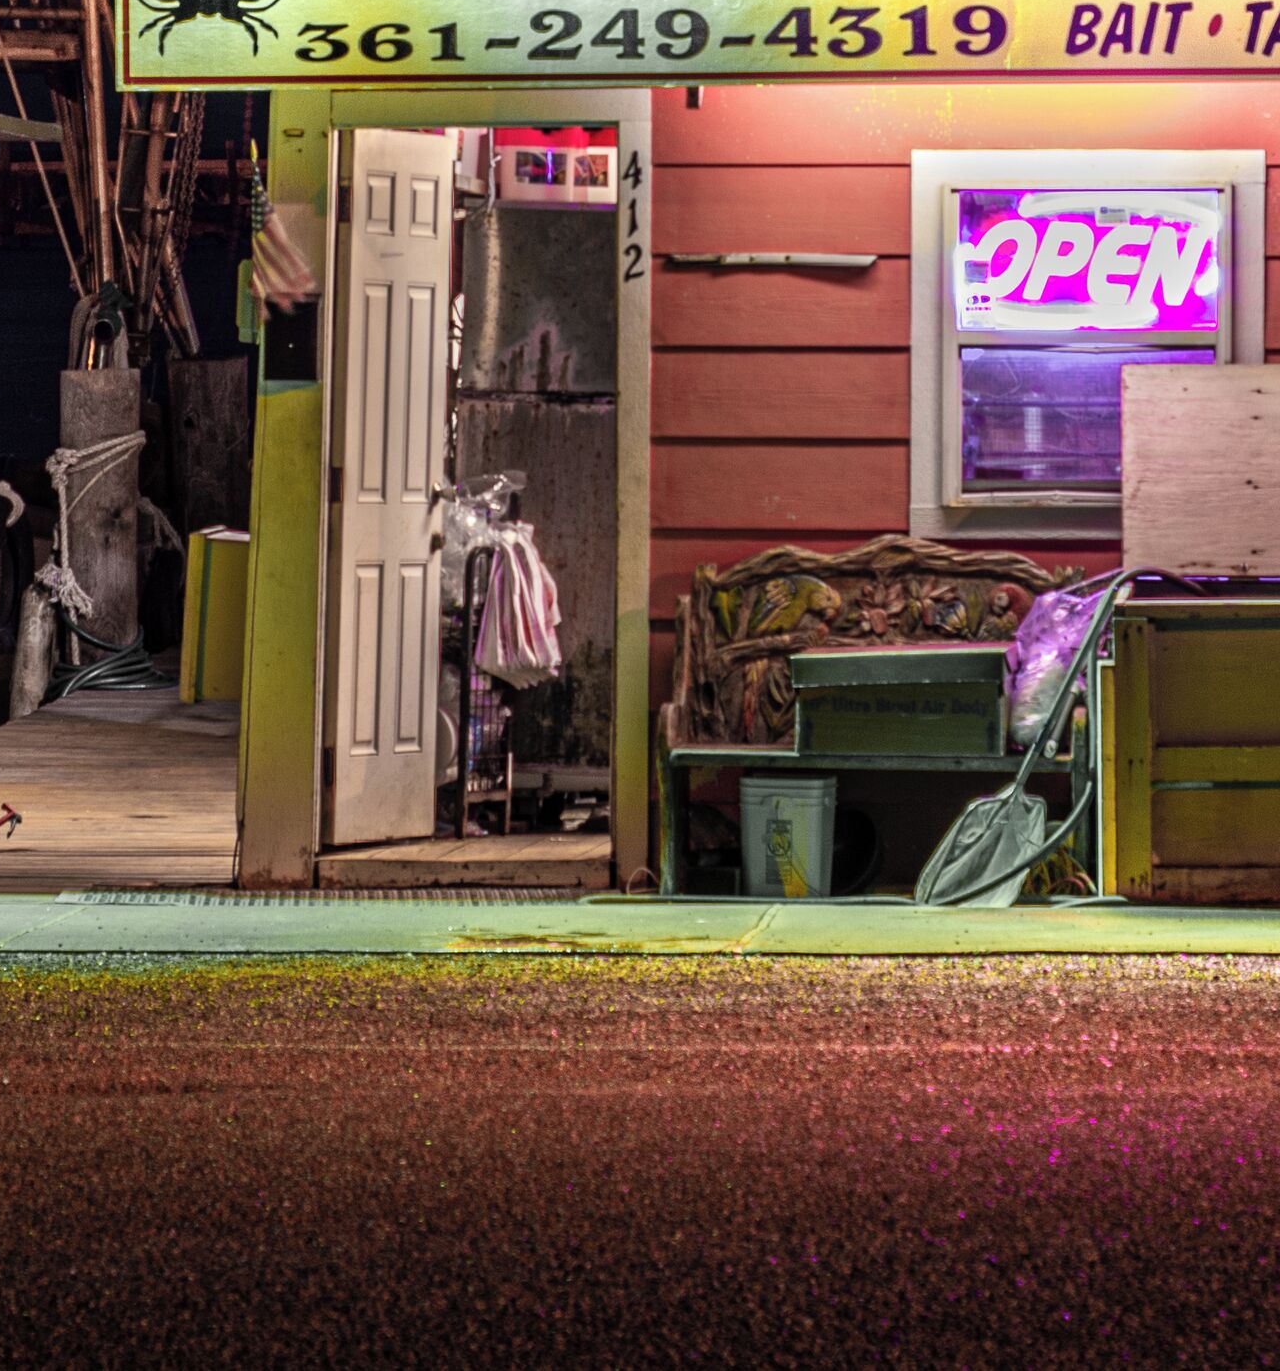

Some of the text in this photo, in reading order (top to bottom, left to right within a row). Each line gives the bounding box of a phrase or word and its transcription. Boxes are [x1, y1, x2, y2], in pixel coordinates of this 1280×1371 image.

[294, 5, 1010, 63] 361-249-4319
[1065, 3, 1194, 56] BAIT
[970, 219, 1208, 307] OPEN
